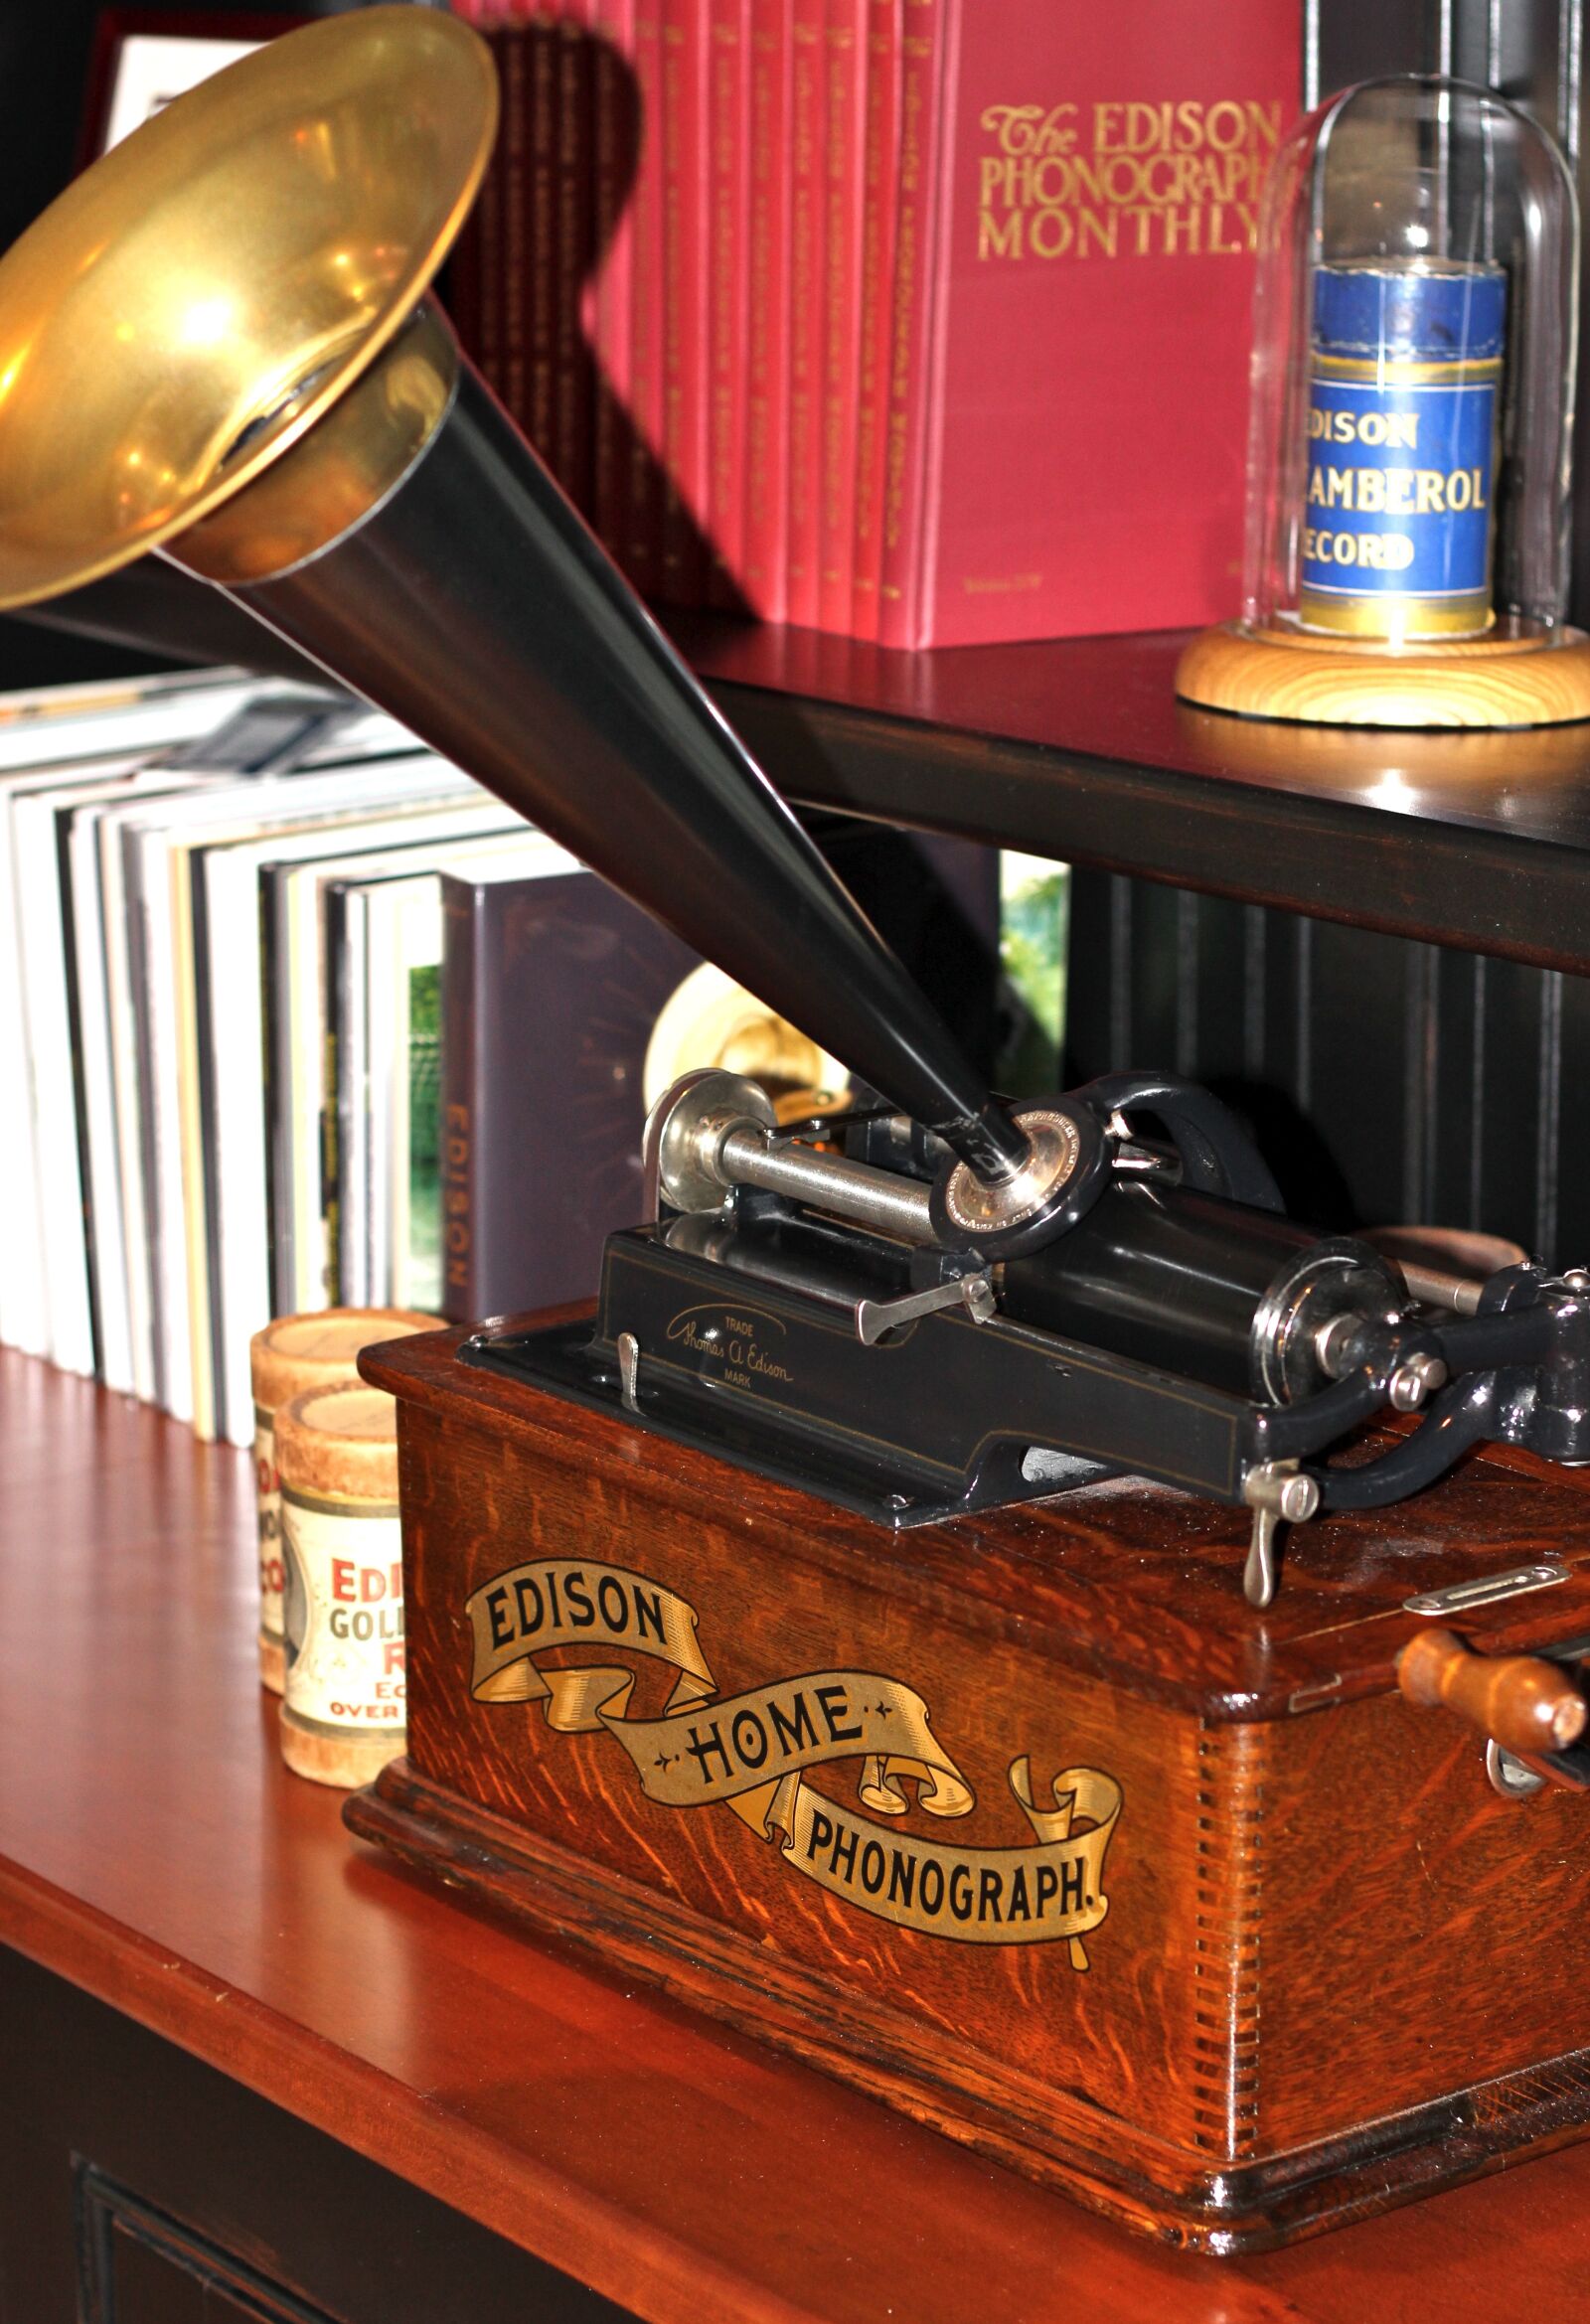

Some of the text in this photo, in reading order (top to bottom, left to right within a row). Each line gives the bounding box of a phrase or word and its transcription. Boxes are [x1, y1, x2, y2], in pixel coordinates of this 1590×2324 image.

[982, 100, 1281, 154] The EDISON
[725, 1317, 753, 1337] TRADE
[724, 1368, 751, 1388] MARK
[748, 1343, 794, 1381] Edison
[485, 1571, 670, 1651] EDISON
[329, 1701, 399, 1719] OVER
[685, 1683, 865, 1785] HOME
[806, 1808, 1096, 1923] PHONOGRAPH.
